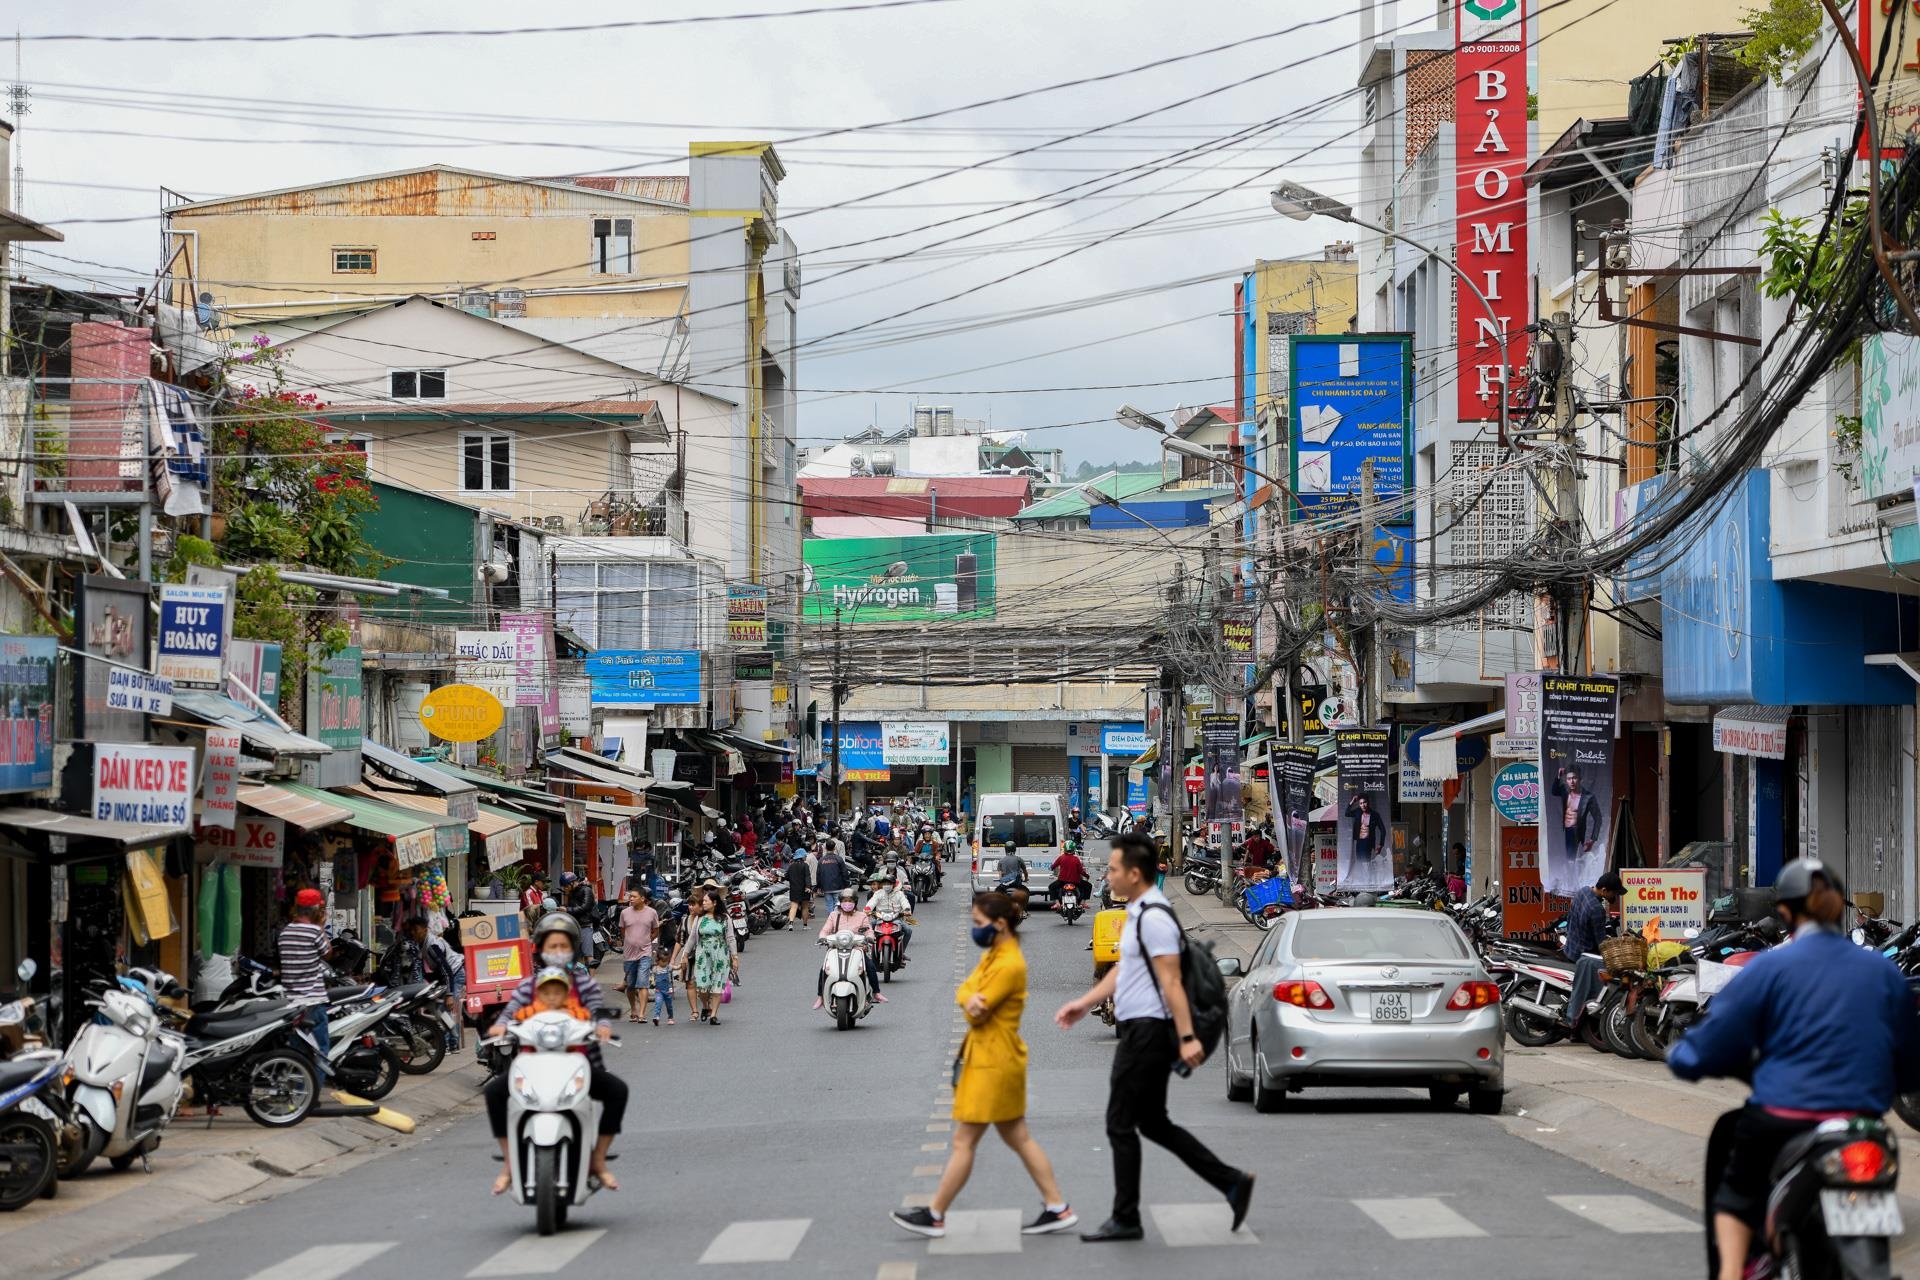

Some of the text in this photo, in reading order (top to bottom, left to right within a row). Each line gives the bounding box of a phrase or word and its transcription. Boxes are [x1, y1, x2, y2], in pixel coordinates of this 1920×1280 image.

[1477, 45, 1520, 53] 9001:2008
[1474, 70, 1510, 200] BẢO
[1470, 222, 1514, 395] MINH
[833, 583, 920, 611] Hydrogen
[730, 598, 764, 614] MARTIN
[175, 606, 210, 626] HUY
[164, 627, 217, 651] HOÀNG
[729, 626, 764, 641] ASAMA
[460, 639, 489, 659] KHẮC
[492, 640, 514, 659] DẤU
[628, 669, 655, 688] Hà
[1545, 680, 1555, 690] LỄ
[1557, 682, 1577, 692] KHAI
[148, 699, 161, 713] XE
[227, 737, 239, 749] XE
[223, 755, 235, 768] XE
[1575, 748, 1607, 760] Dalat
[100, 751, 188, 793] DÁN KEO XE
[114, 803, 139, 822] INOX
[171, 797, 187, 825] SỐ
[245, 823, 277, 849] Xe
[1508, 881, 1542, 904] BÚN
[1638, 886, 1699, 901] Cần Thơ
[468, 997, 481, 1007] 13
[1379, 993, 1403, 1007] 49X
[1375, 1006, 1408, 1020] 8695
